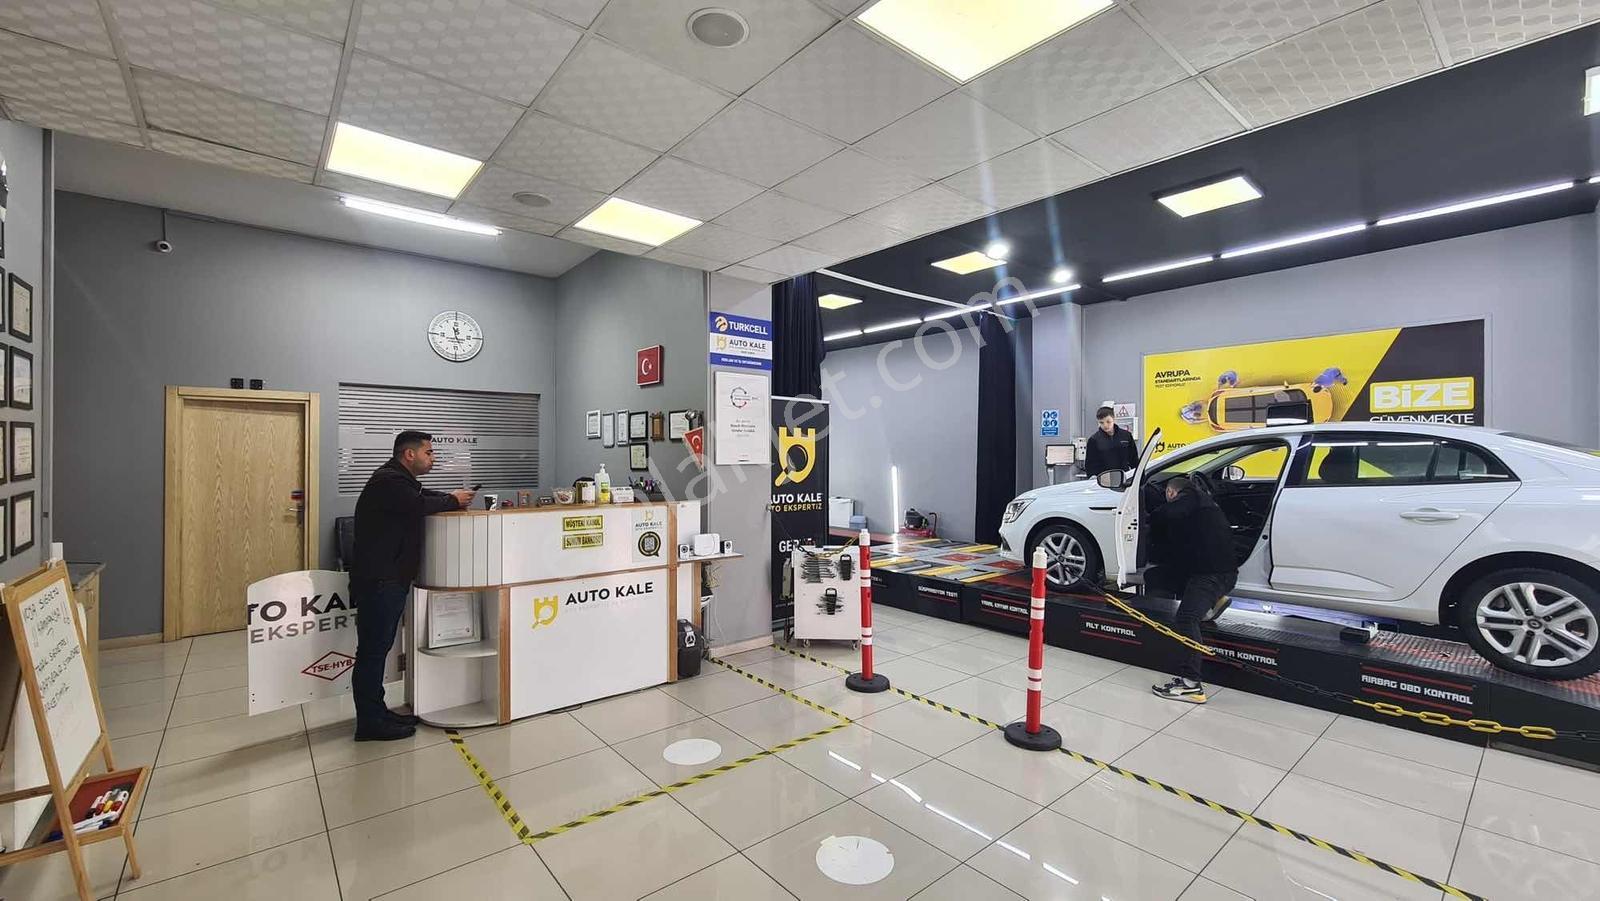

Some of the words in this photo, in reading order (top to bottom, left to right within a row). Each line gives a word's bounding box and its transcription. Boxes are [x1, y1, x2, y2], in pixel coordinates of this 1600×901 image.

[729, 321, 768, 335] TURKCELL
[730, 339, 748, 347] AUTO
[750, 341, 766, 350] KALE
[1155, 369, 1190, 379] AVRUPA
[797, 492, 822, 503] KALE
[565, 588, 610, 606] AUTO
[615, 582, 653, 598] KALE
[1085, 621, 1100, 630] ALT
[1101, 624, 1136, 637] KONTROL
[311, 658, 353, 673] TSE-HYB
[1237, 651, 1278, 666] KONTROL
[1361, 674, 1397, 689] AIRBAG
[1400, 682, 1421, 694] OBD
[1424, 687, 1473, 705] KONTROL
